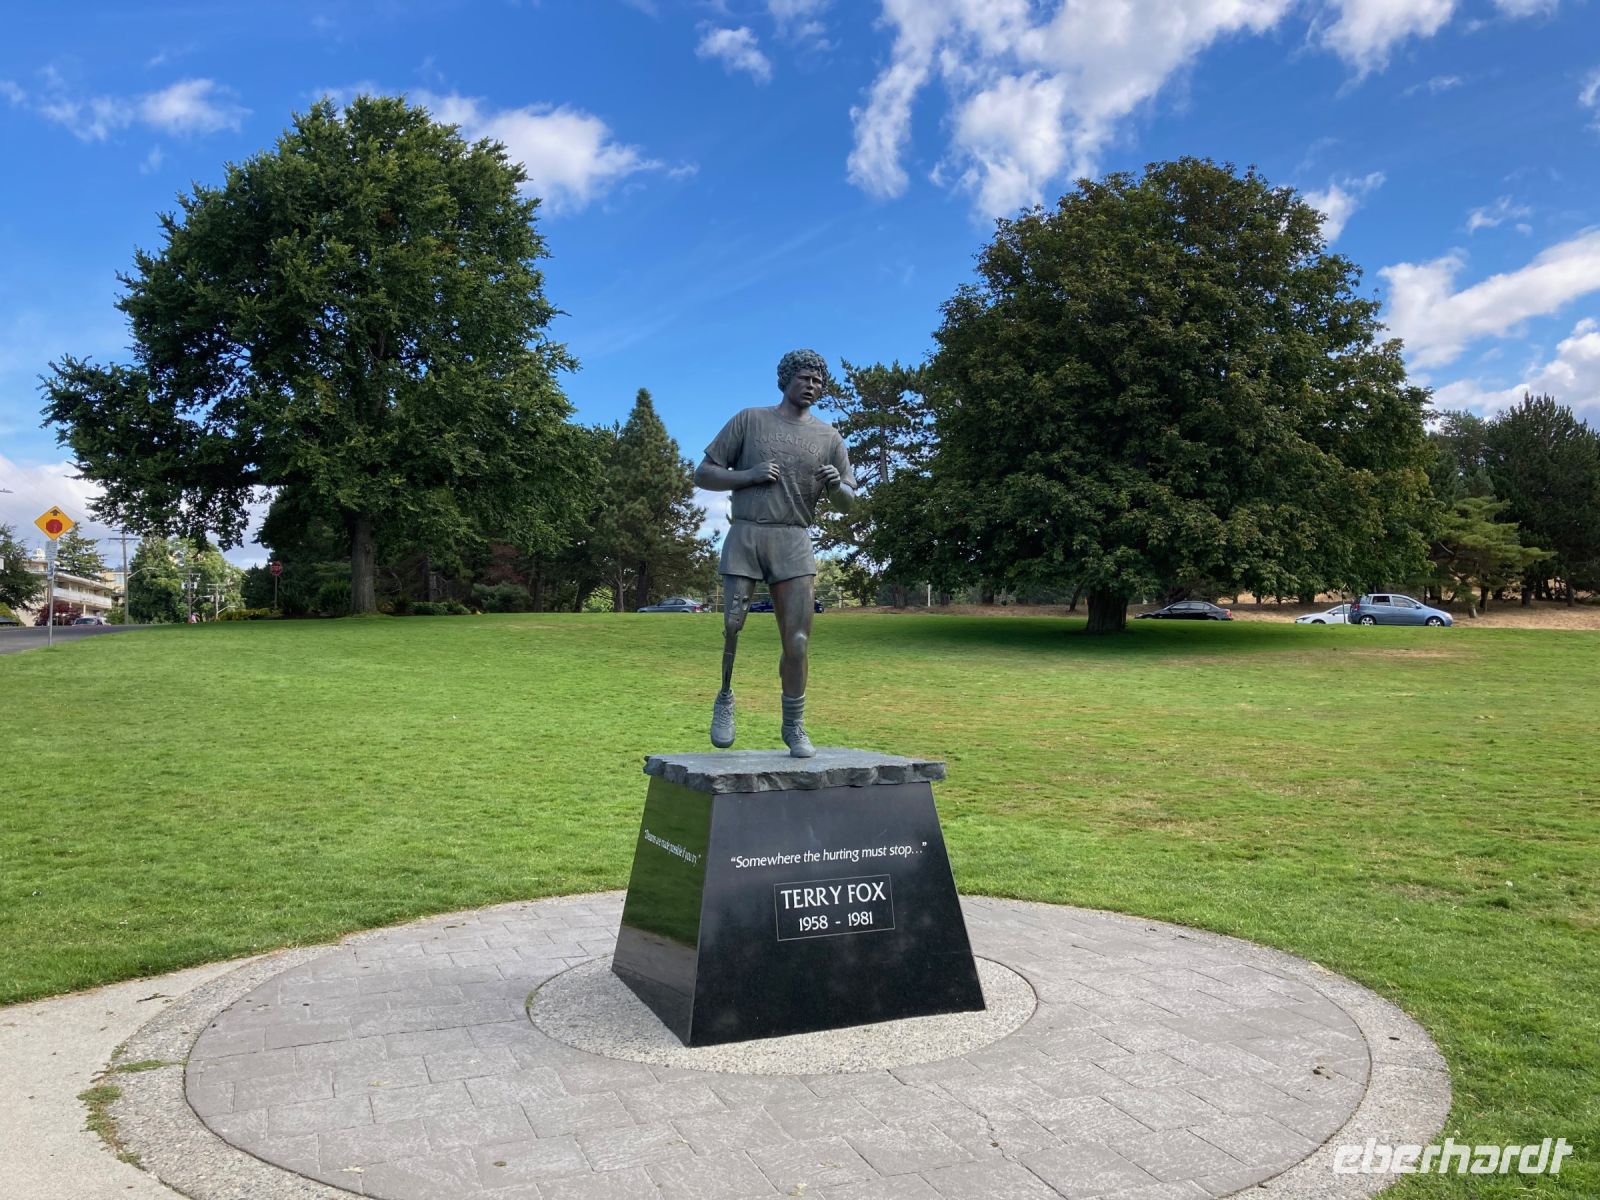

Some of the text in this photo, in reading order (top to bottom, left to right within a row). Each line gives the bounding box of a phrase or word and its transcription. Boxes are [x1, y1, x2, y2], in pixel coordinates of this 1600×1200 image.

[730, 853, 801, 869] “Somewhere
[803, 849, 820, 862] the
[822, 847, 859, 862] hurting
[861, 845, 887, 857] must
[780, 881, 887, 910] TERRY FOX
[798, 914, 829, 932] 1958
[847, 910, 874, 927] 1981
